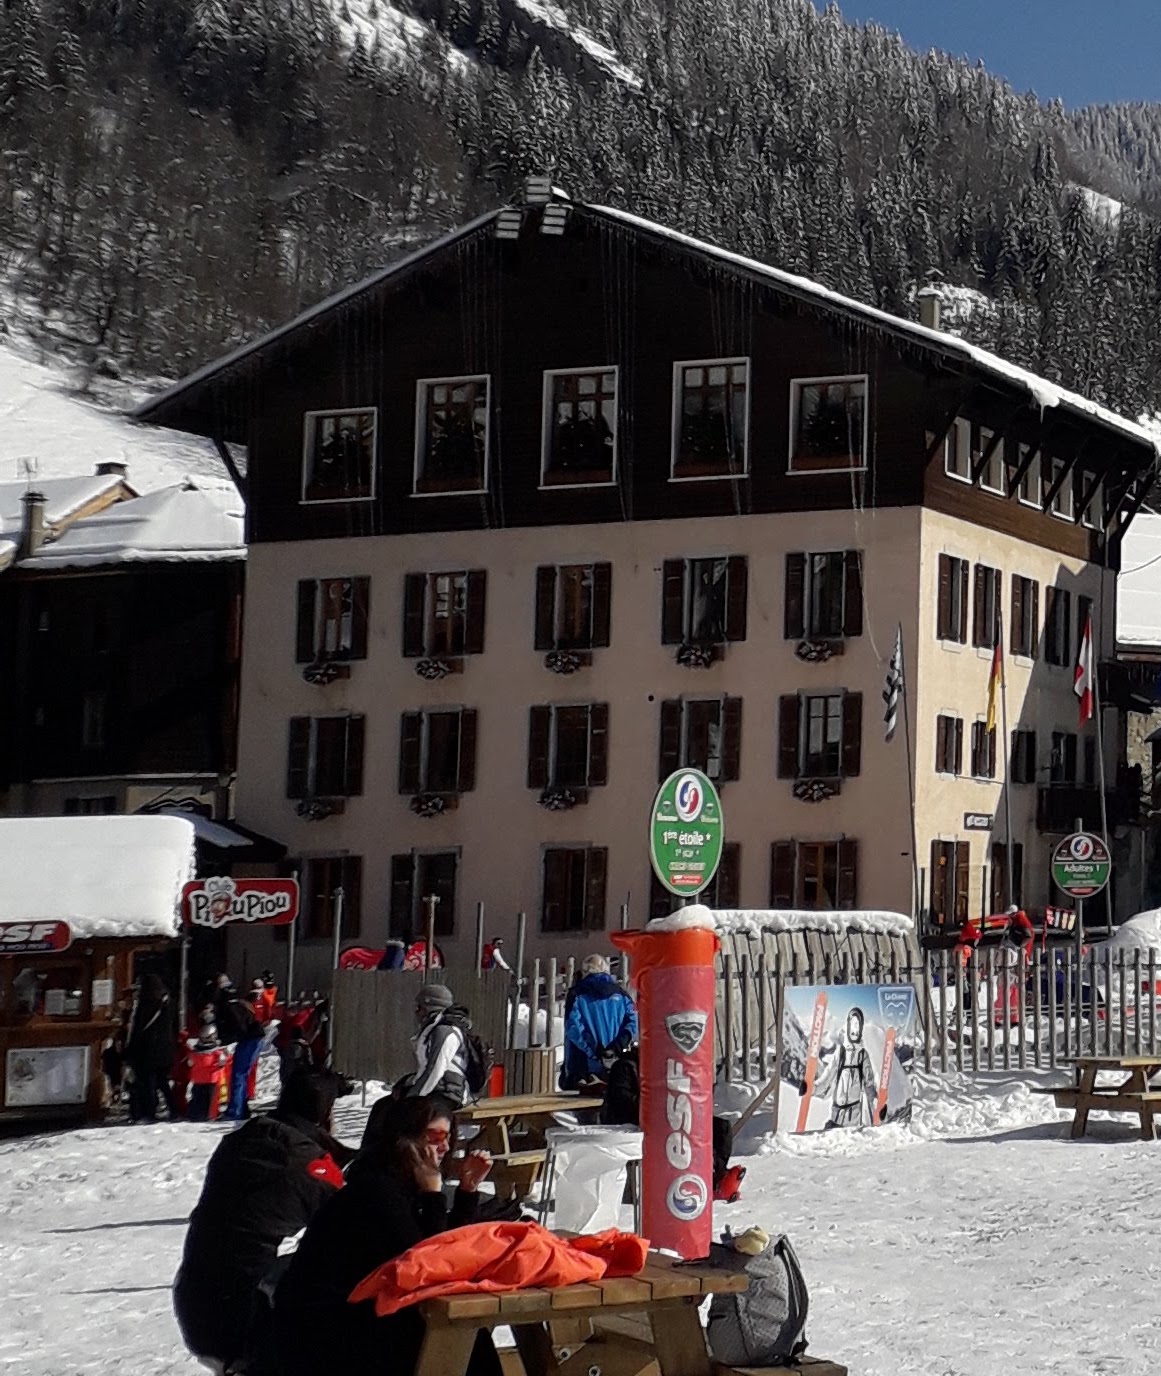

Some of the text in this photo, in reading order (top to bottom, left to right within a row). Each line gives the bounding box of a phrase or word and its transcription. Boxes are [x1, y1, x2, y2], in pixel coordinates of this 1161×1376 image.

[679, 830, 703, 846] étoile
[1064, 863, 1093, 873] Adultes
[0, 923, 58, 943] SF
[809, 1003, 826, 1059] FACTION
